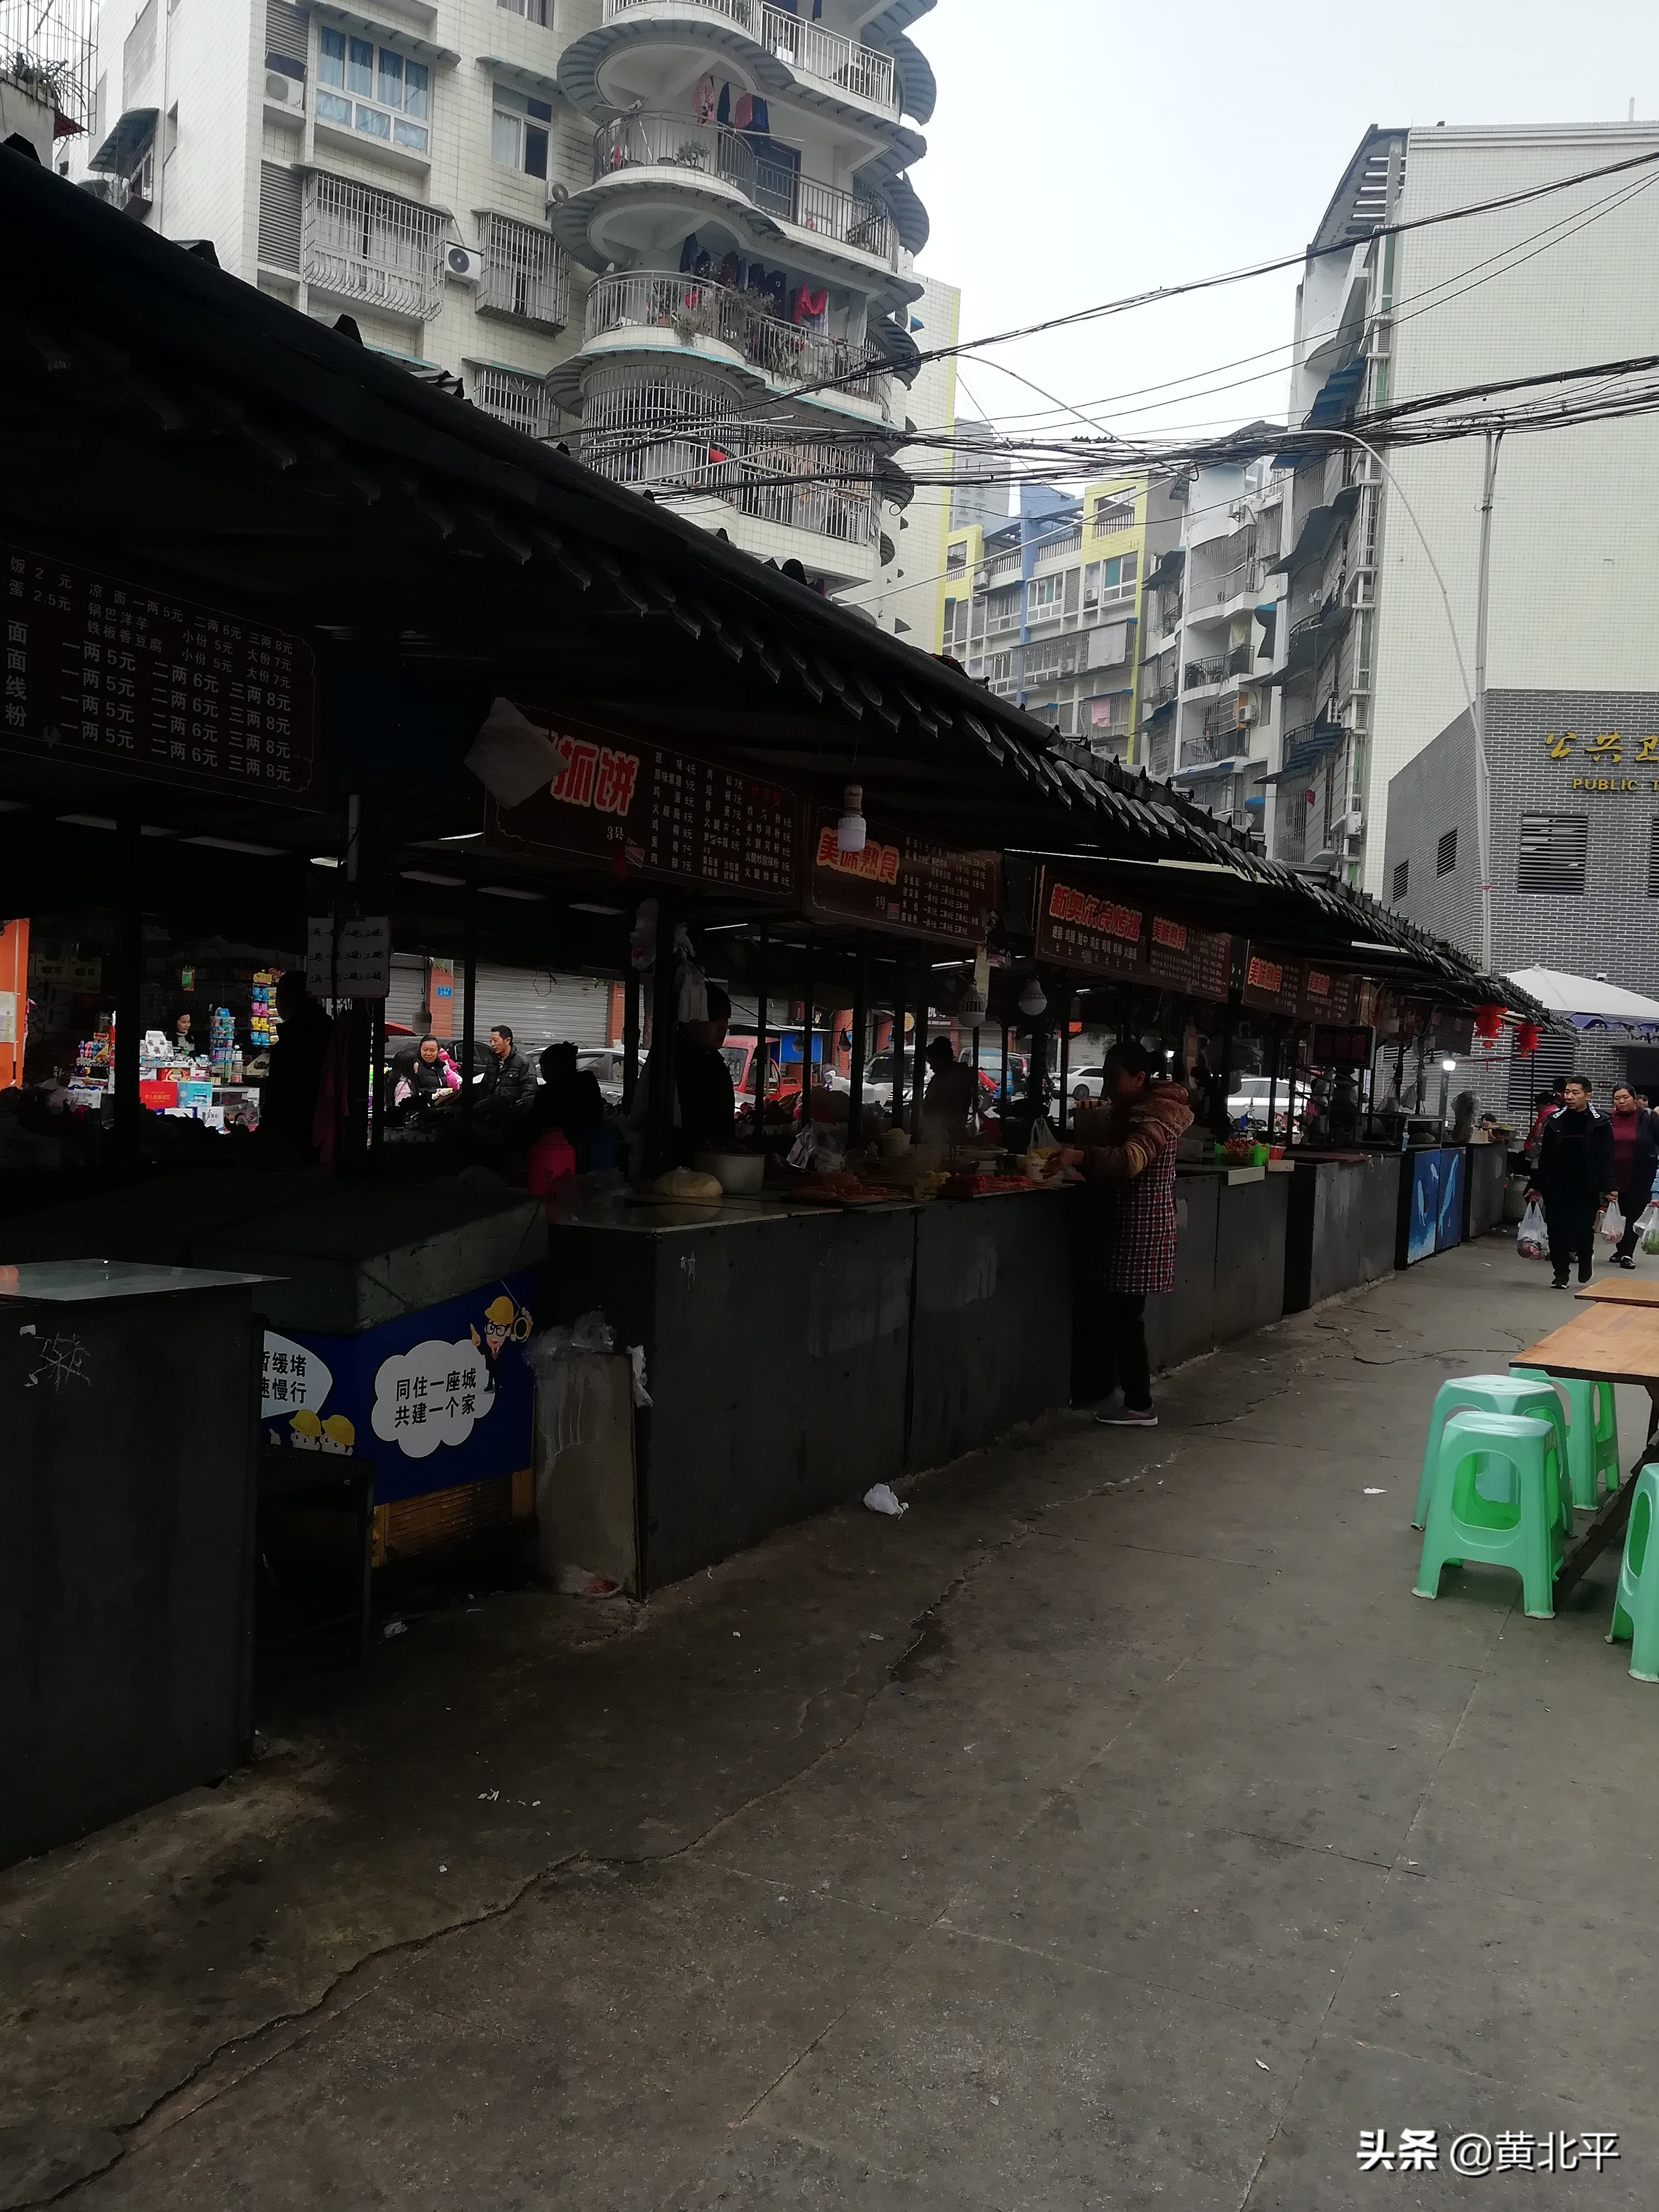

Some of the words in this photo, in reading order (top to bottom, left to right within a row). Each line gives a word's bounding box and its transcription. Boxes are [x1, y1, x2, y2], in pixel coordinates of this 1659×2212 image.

[7, 619, 28, 646] 面
[7, 647, 27, 673] 面
[5, 674, 27, 701] 线
[4, 702, 27, 727] 粉
[545, 728, 640, 818] 抓饼
[1572, 778, 1638, 792] PUBLIC
[1049, 882, 1143, 942] 新奥尔良烤翅
[395, 1366, 477, 1402] 同住一座城
[394, 1393, 476, 1428] 共建一个家
